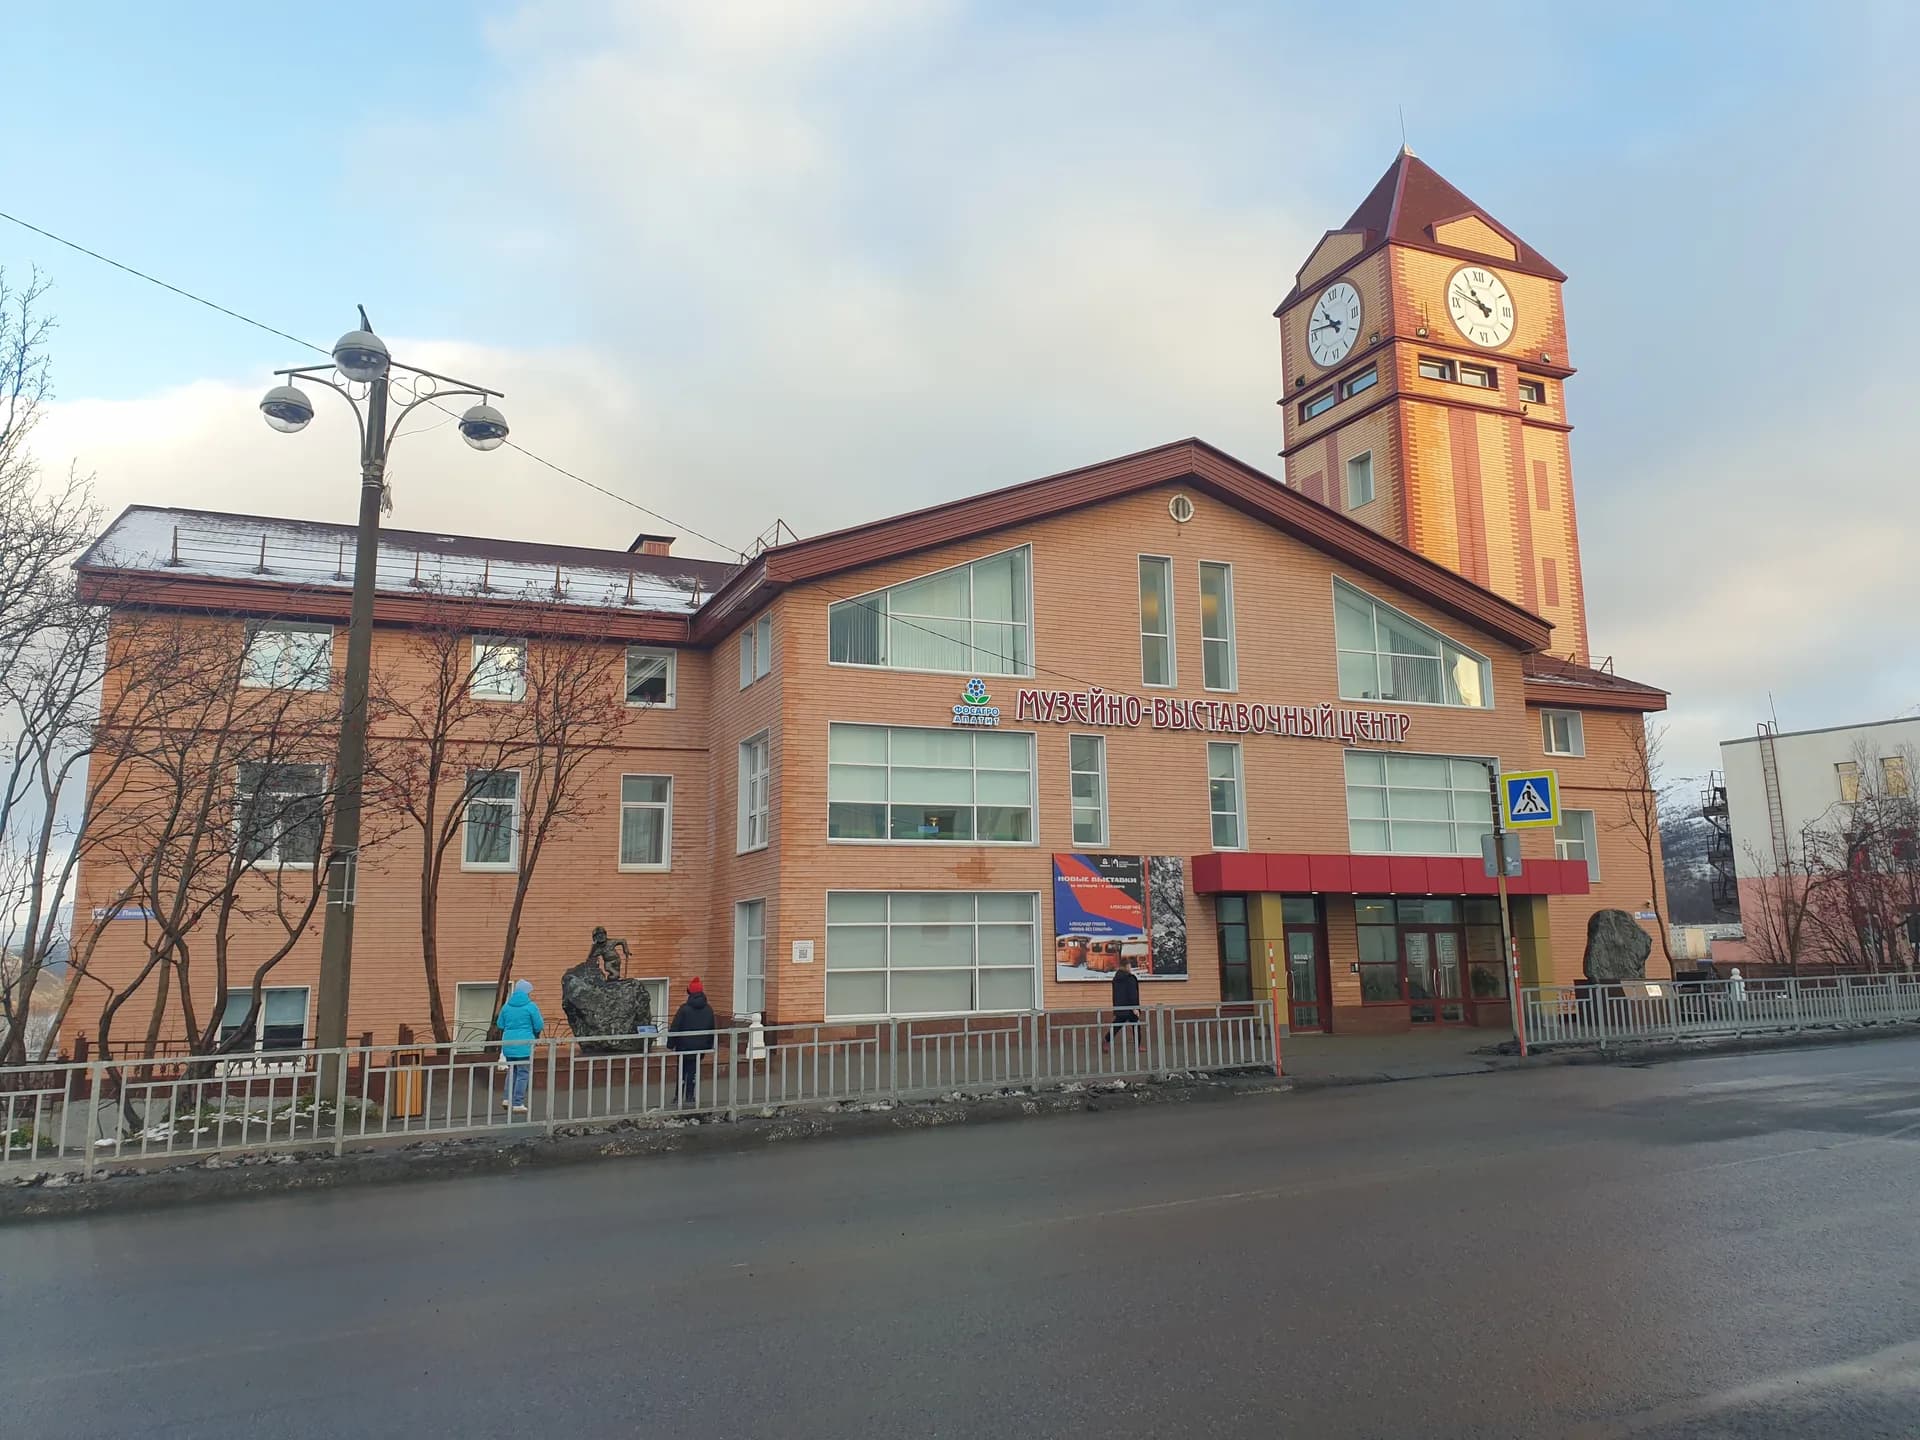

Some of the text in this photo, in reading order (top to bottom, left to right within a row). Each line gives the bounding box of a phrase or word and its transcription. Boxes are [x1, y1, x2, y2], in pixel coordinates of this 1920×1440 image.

[1473, 271, 1484, 283] XII
[1327, 288, 1337, 303] XII
[1452, 297, 1461, 308] IX
[1351, 305, 1359, 319] III
[1502, 306, 1511, 318] III
[1311, 331, 1319, 343] IX
[1480, 332, 1488, 343] VI
[1332, 348, 1339, 360] VI
[952, 705, 1000, 717] ФОСАГРО
[1016, 687, 1412, 744] МУЗЕЙНО-ВЫСТАВОЧНЫЙ ЦЕНТР
[952, 715, 999, 726] АПАТИТ
